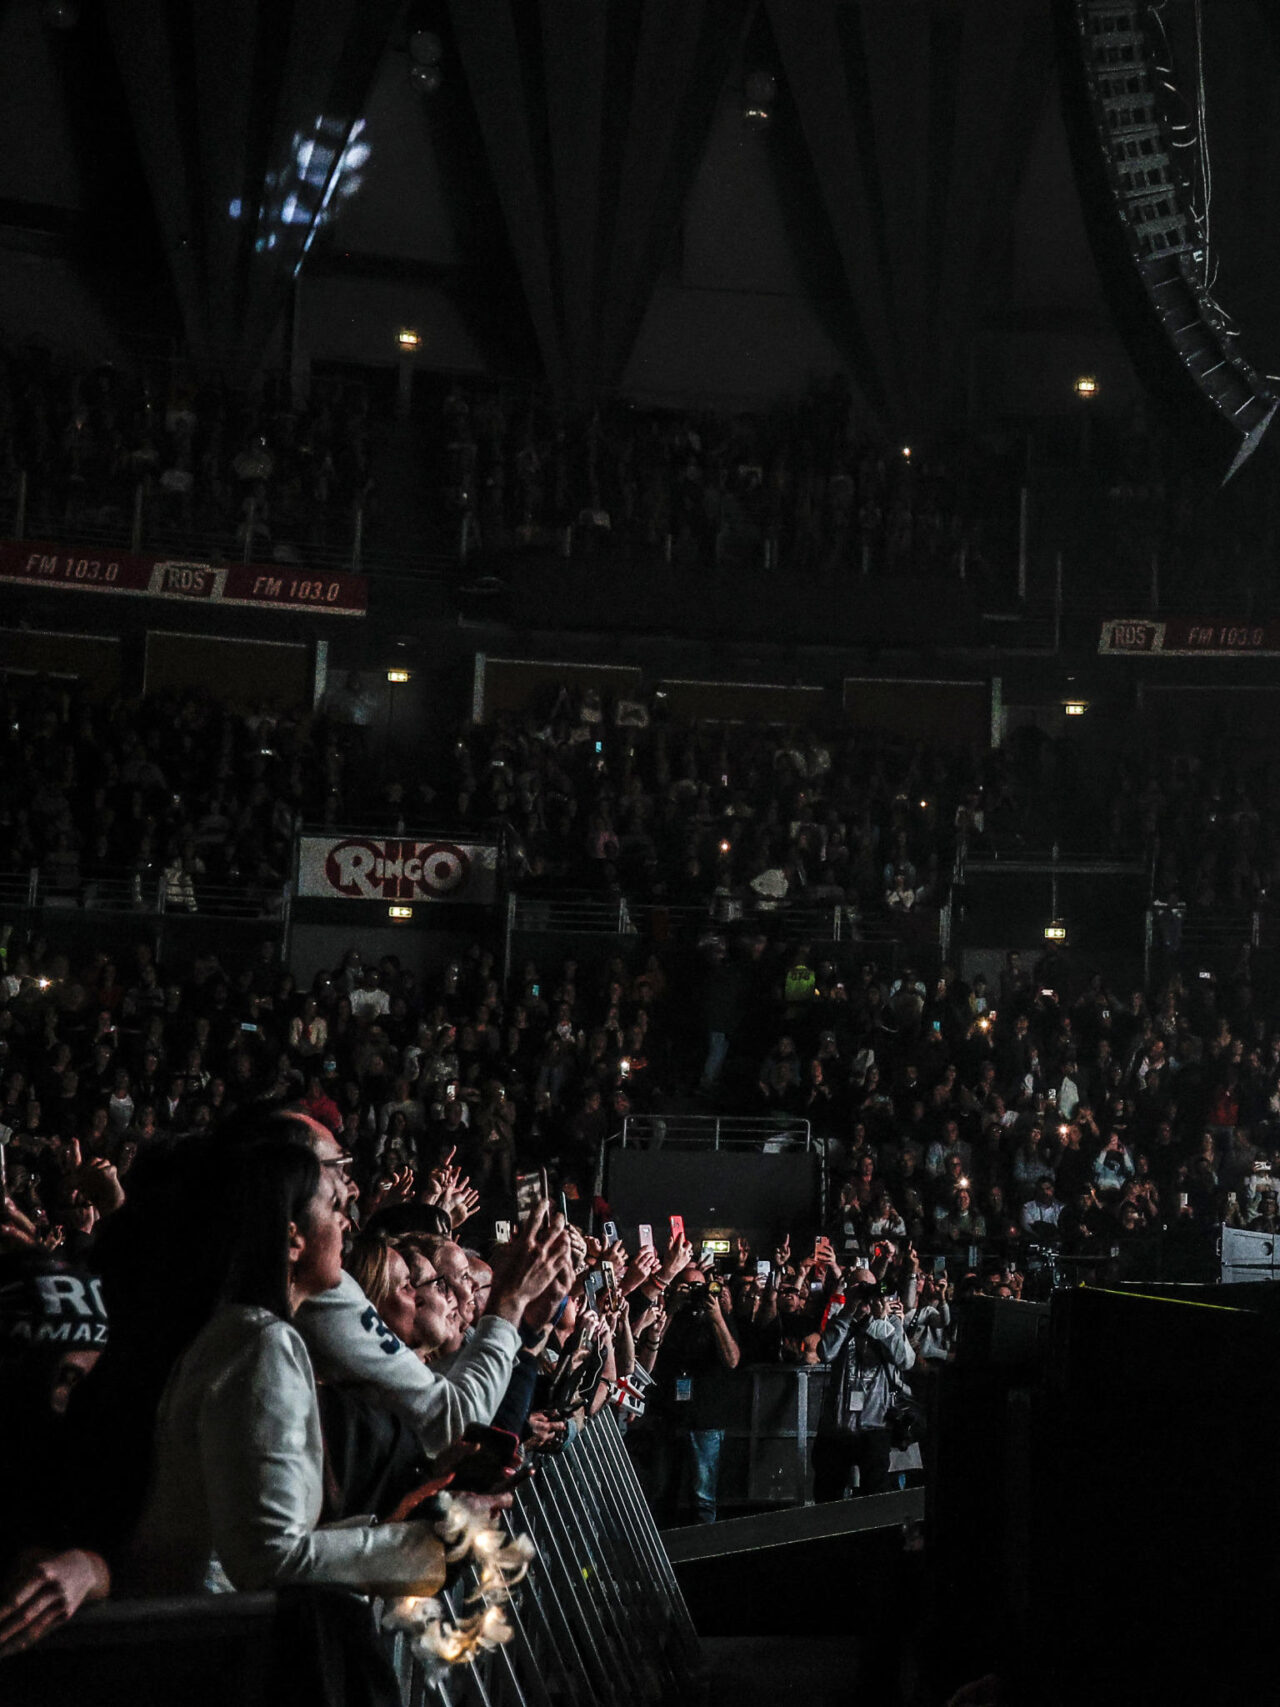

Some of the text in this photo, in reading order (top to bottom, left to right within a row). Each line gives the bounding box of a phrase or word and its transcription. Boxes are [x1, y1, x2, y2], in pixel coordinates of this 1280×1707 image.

[25, 554, 120, 583] FM 103.0
[167, 568, 207, 591] RDS
[252, 576, 341, 602] FM 103.0
[1114, 626, 1147, 645] RDS
[1188, 627, 1266, 646] FM 103.0
